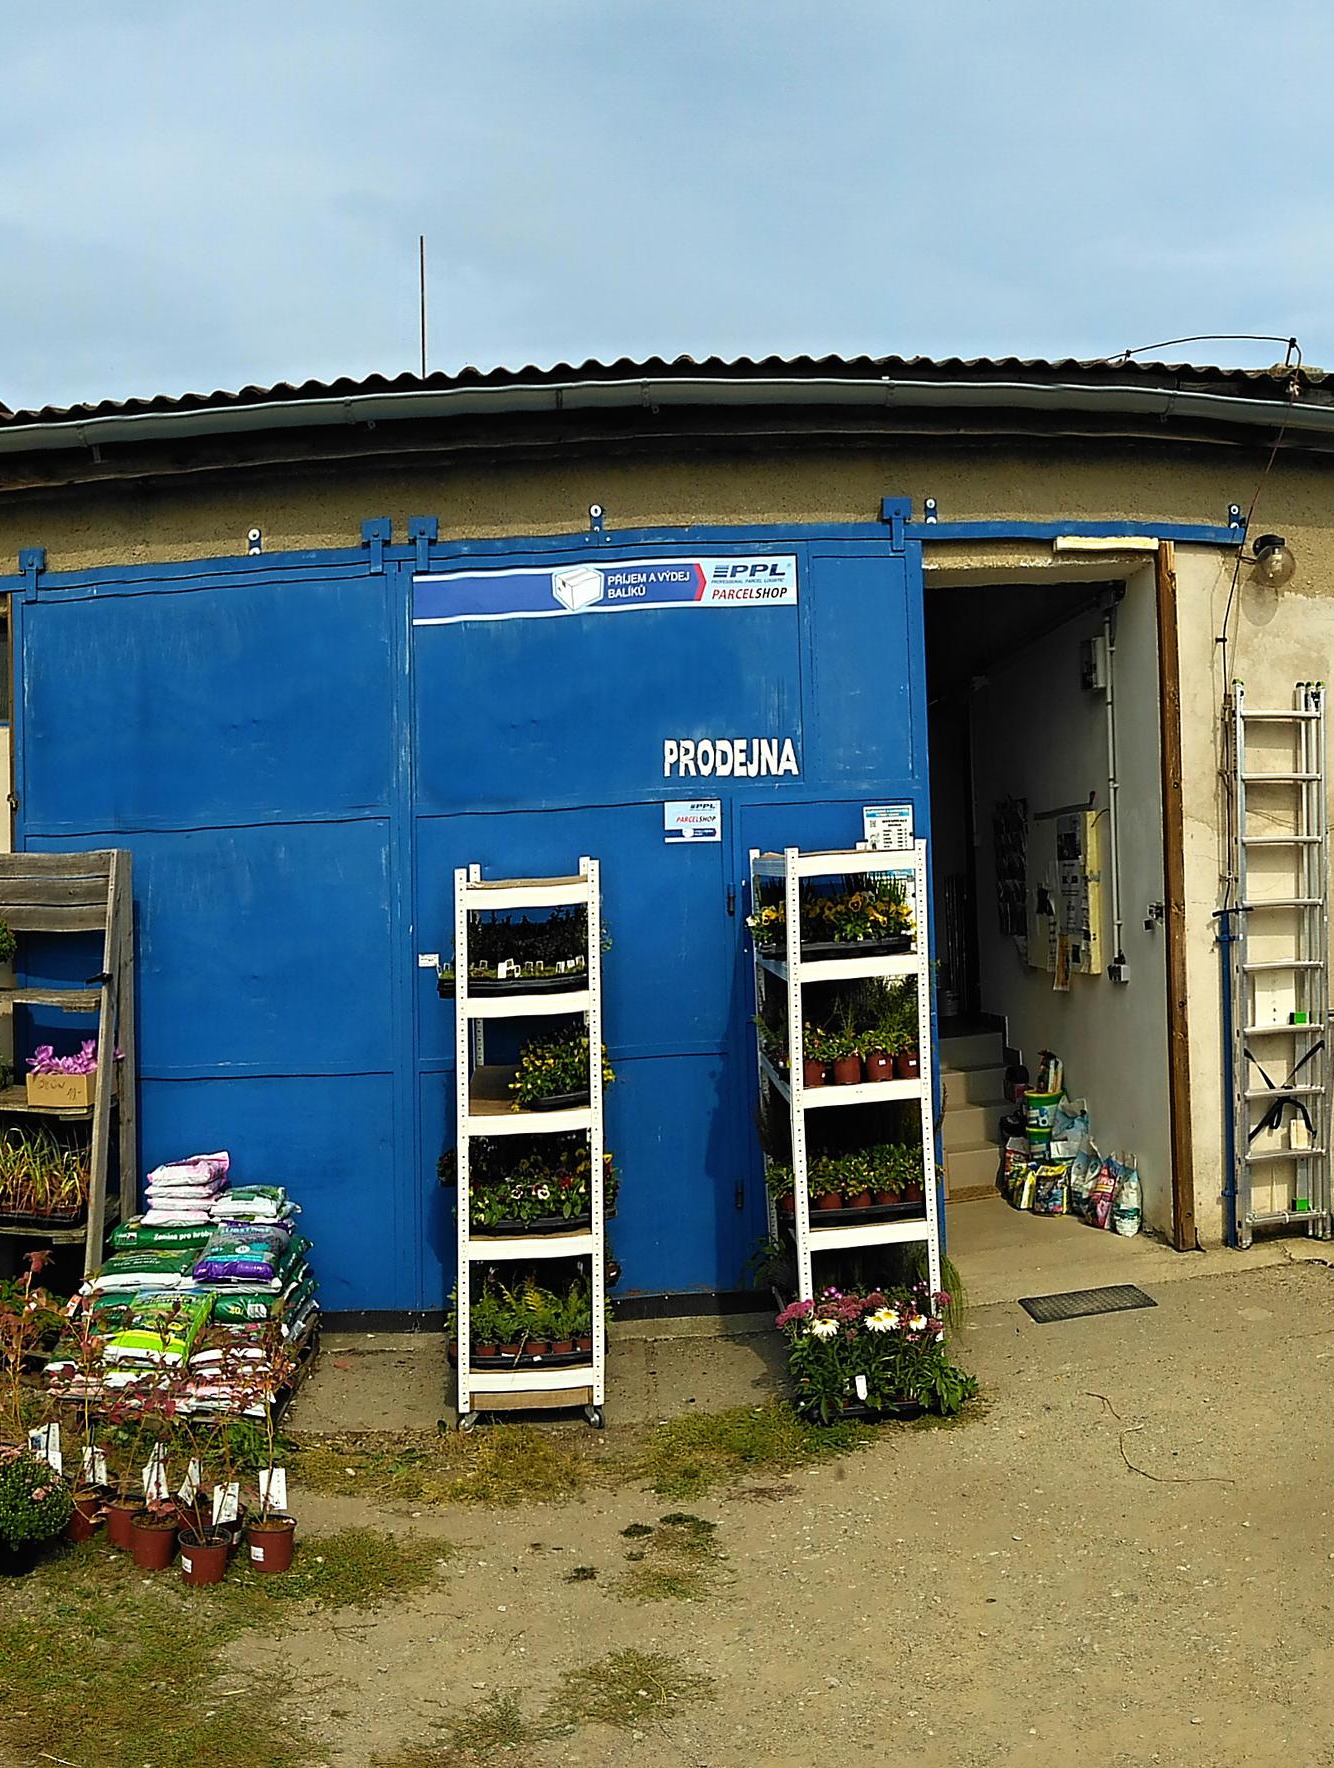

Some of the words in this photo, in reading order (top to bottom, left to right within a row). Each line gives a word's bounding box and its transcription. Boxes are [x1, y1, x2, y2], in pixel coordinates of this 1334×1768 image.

[649, 572, 656, 583] A
[657, 569, 689, 583] VÝDEJ
[730, 563, 786, 578] PPL
[608, 584, 646, 598] BALÍKŮ
[712, 587, 787, 600] PARCELSHOP
[664, 738, 799, 777] PRODEJNA
[179, 1233, 192, 1241] pro
